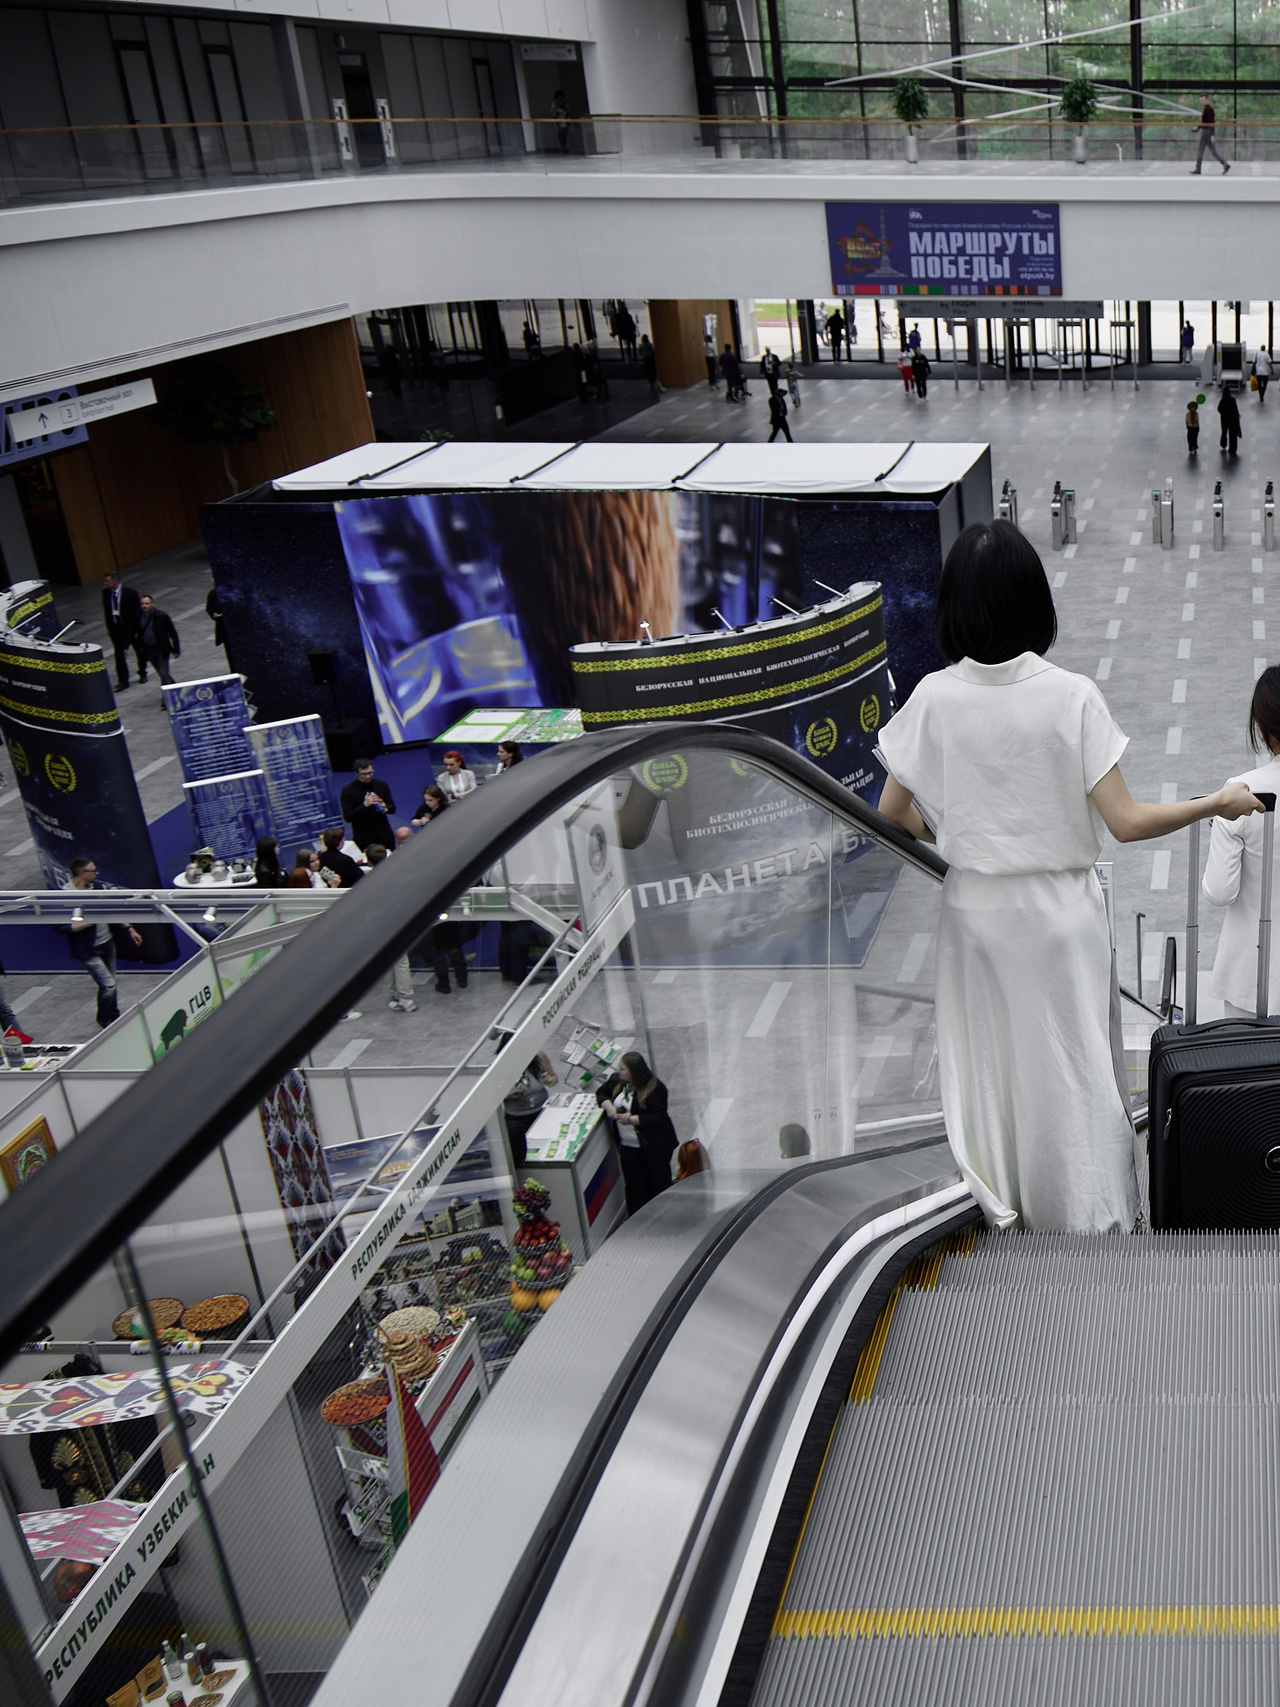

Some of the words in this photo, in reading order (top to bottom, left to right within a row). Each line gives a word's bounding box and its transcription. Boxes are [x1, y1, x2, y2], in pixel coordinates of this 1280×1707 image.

[908, 231, 1055, 255] МАРШРУТЫ
[910, 255, 1011, 282] ПОБЕДЫ
[1020, 271, 1054, 280] otpusk.by
[66, 408, 73, 418] 3
[79, 391, 121, 410] Выставочный
[121, 389, 134, 399] зал
[635, 678, 693, 692] БЕЛОРУССКАЯ
[698, 667, 762, 684] НАЦИОНАЛЬНАЯ
[766, 644, 840, 671] БИОТЕХНОЛОГИЧЕСКАЯ
[709, 799, 788, 824] БЕЛОРУССКАЯ
[637, 841, 827, 908] ПЛАНЕТА
[188, 985, 212, 1014] ГЦВ
[351, 1202, 407, 1281] РЕСПУБЛИКА
[406, 1128, 462, 1207] ТАДЖИКИСТАН
[42, 1562, 137, 1692] РЕСПУБЛИКА
